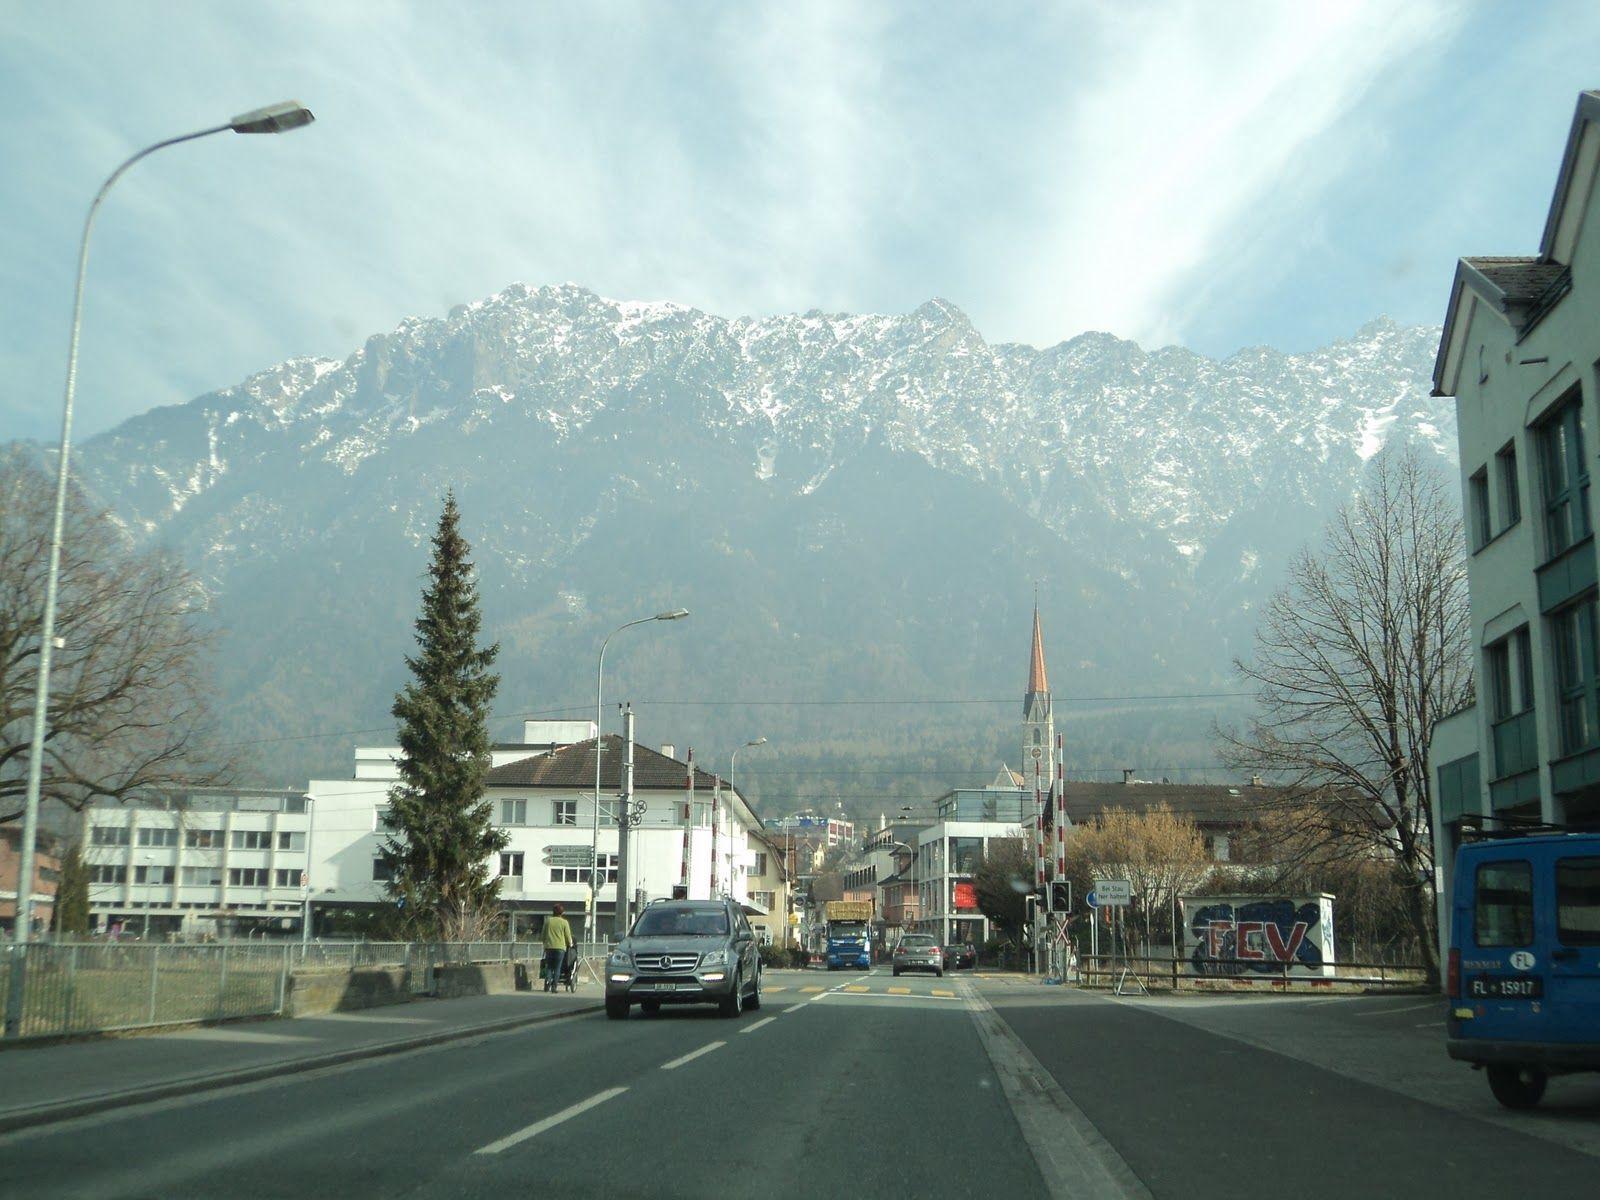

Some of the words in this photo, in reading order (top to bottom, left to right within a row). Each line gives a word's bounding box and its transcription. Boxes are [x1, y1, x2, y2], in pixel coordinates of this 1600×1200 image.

[1516, 953, 1531, 968] FL
[1473, 981, 1488, 995] FL
[1500, 981, 1534, 995] 15917
